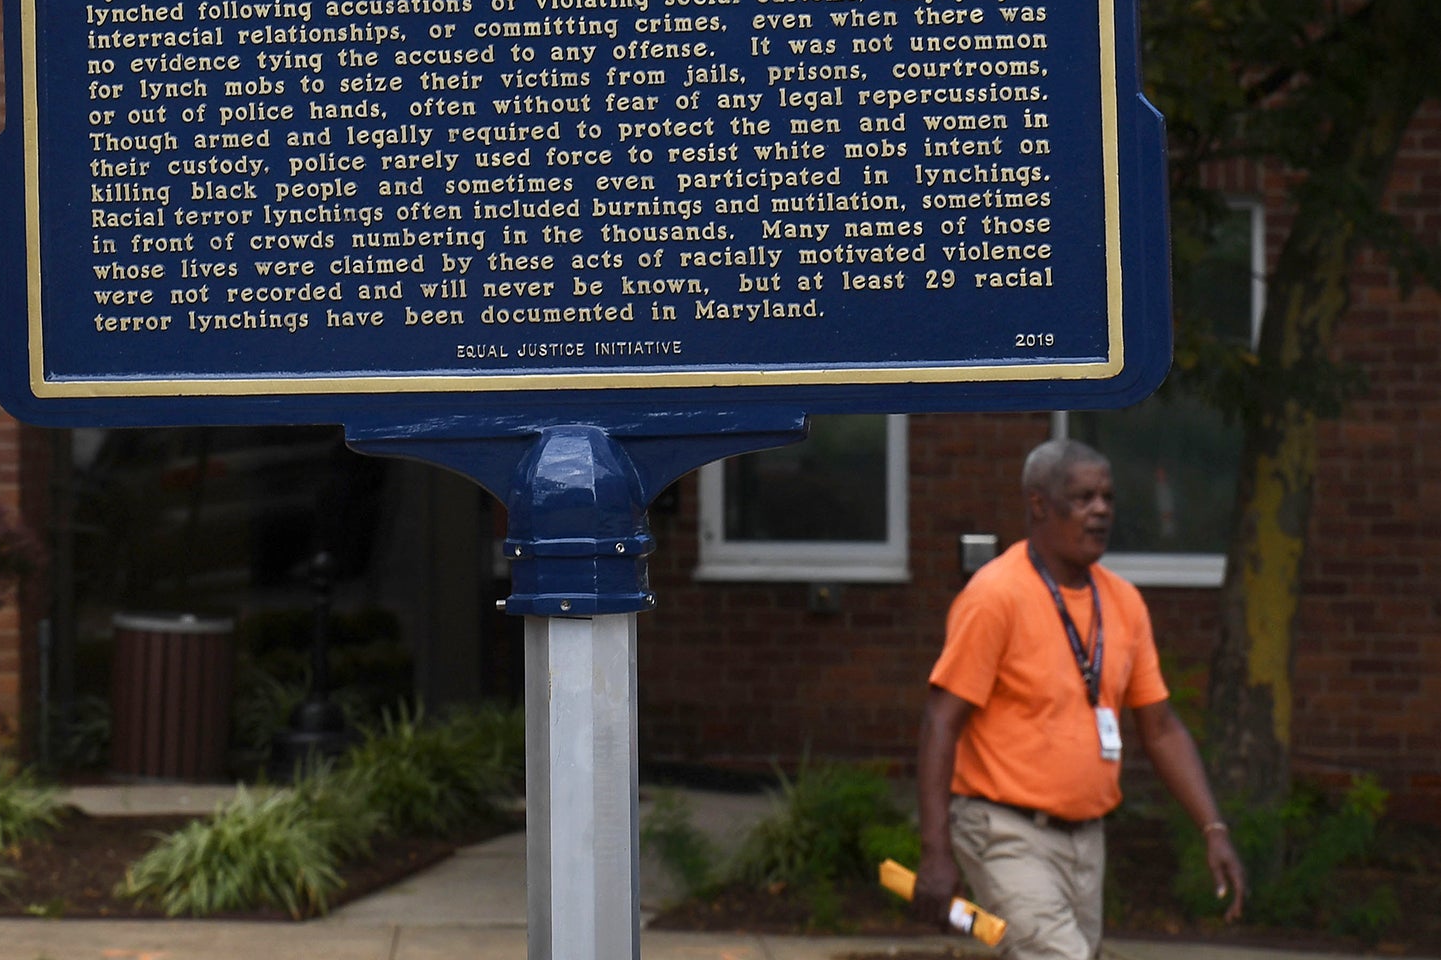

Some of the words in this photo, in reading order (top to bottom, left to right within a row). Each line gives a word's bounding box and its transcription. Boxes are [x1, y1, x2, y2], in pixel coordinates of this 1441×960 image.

[88, 26, 222, 48] interracial
[237, 21, 405, 44] relationships,
[429, 23, 455, 38] or
[474, 15, 618, 38] committing
[635, 13, 726, 32] crimes,
[752, 13, 812, 29] even
[829, 8, 898, 26] when
[914, 6, 983, 24] there
[998, 6, 1046, 21] was
[88, 80, 123, 99] for
[139, 78, 206, 100] lynch
[224, 75, 284, 95] mobs
[300, 75, 324, 92] to
[339, 72, 402, 91] seize
[419, 70, 482, 90] their
[500, 67, 589, 87] victims
[606, 66, 665, 85] from
[683, 63, 745, 87] jails,
[767, 61, 866, 85] prisons,
[892, 58, 1047, 77] courtrooms,
[89, 110, 114, 124] or
[128, 105, 166, 123] out
[181, 103, 206, 122] of
[218, 101, 293, 125] police
[309, 99, 386, 119] hands,
[409, 97, 476, 115] often
[492, 94, 590, 113] without
[605, 93, 658, 111] fear
[675, 90, 700, 109] of
[717, 93, 762, 111] any
[778, 86, 842, 111] legal
[858, 82, 1047, 109] repercussions.
[89, 157, 149, 176] their
[168, 155, 268, 176] custody,
[288, 152, 366, 176] police
[380, 149, 458, 171] rarely
[475, 147, 530, 167] used
[546, 146, 612, 165] force
[627, 144, 652, 163] to
[667, 142, 737, 161] resist
[753, 140, 824, 159] white
[844, 138, 906, 157] mobs
[924, 136, 1002, 156] intent
[1020, 138, 1050, 153] on
[91, 207, 164, 227] Racial
[173, 207, 252, 225] terror
[263, 203, 382, 226] lynchings
[396, 201, 461, 220] often
[473, 198, 579, 218] included
[592, 196, 701, 219] burnings
[715, 194, 759, 213] and
[771, 191, 905, 212] mutilation,
[922, 188, 1050, 208] sometimes
[92, 235, 116, 253] in
[130, 232, 193, 252] front
[210, 231, 234, 250] of
[250, 230, 334, 249] crowds
[351, 226, 485, 250] numbering
[503, 225, 528, 244] in
[541, 224, 583, 243] the
[600, 221, 733, 241] thousands.
[762, 219, 829, 241] Many
[844, 221, 922, 236] names
[941, 216, 966, 234] of
[981, 215, 1050, 233] those
[93, 289, 153, 304] were
[170, 284, 209, 303] not
[227, 281, 341, 301] recorded
[358, 280, 402, 299] and
[419, 278, 466, 297] will
[483, 281, 554, 296] never
[573, 276, 602, 295] be
[621, 275, 708, 295] known,
[738, 272, 780, 291] but
[797, 271, 822, 290] at
[842, 270, 904, 289] least
[925, 268, 954, 288] 29
[974, 266, 1052, 287] racial
[93, 313, 171, 331] terror
[188, 309, 307, 332] lynchings
[326, 309, 383, 326] have
[404, 306, 464, 324] been
[480, 302, 633, 323] documented
[651, 300, 676, 320] in
[695, 298, 823, 321] Maryland.
[457, 344, 509, 359] EQUAL
[517, 343, 585, 357] JUSTICE
[595, 340, 682, 355] INITIATIVE
[1015, 332, 1054, 347] 2019
